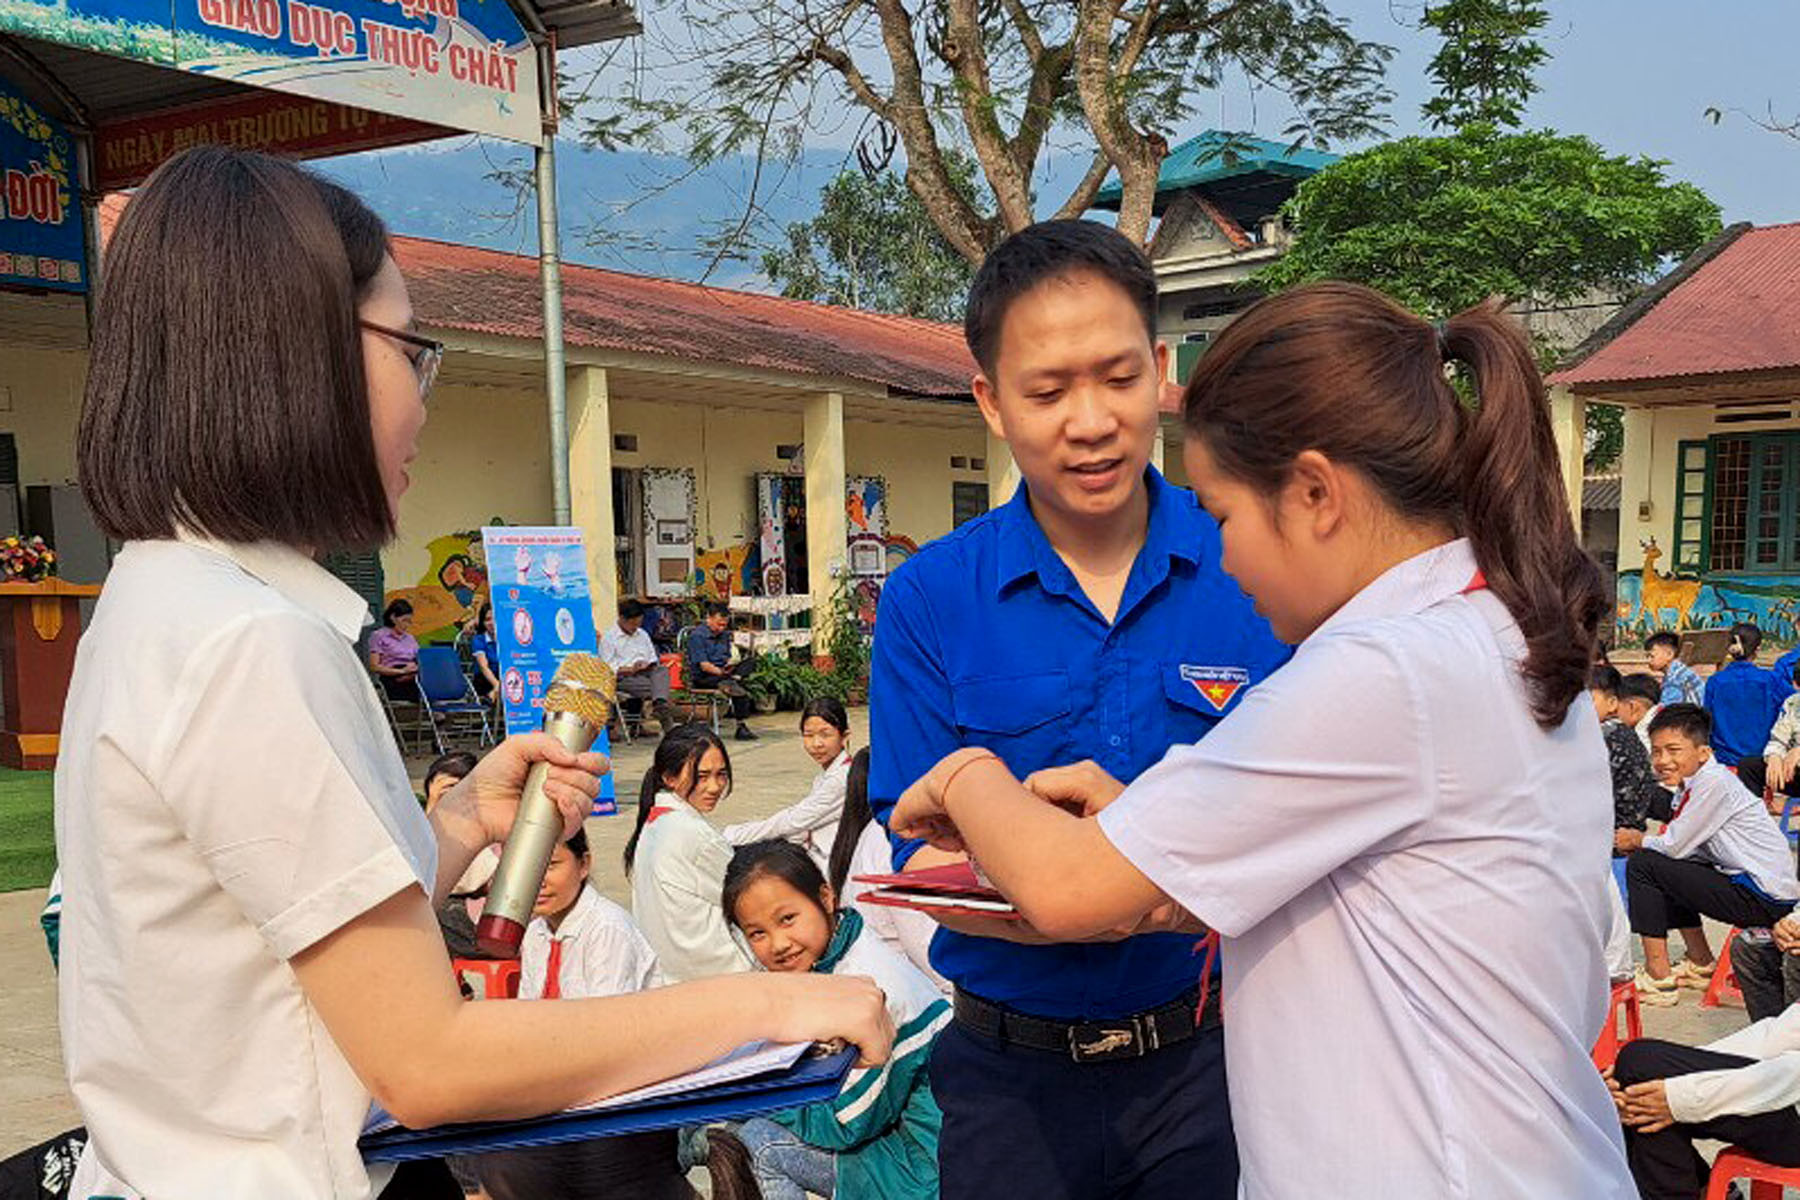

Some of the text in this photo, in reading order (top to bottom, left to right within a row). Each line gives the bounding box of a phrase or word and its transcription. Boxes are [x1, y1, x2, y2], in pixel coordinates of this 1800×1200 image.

[288, 1, 357, 57] DỤC
[362, 19, 440, 77] THỰC
[448, 40, 518, 93] CHẤT
[105, 128, 165, 169] NGÀY
[7, 160, 63, 224] ĐỜI
